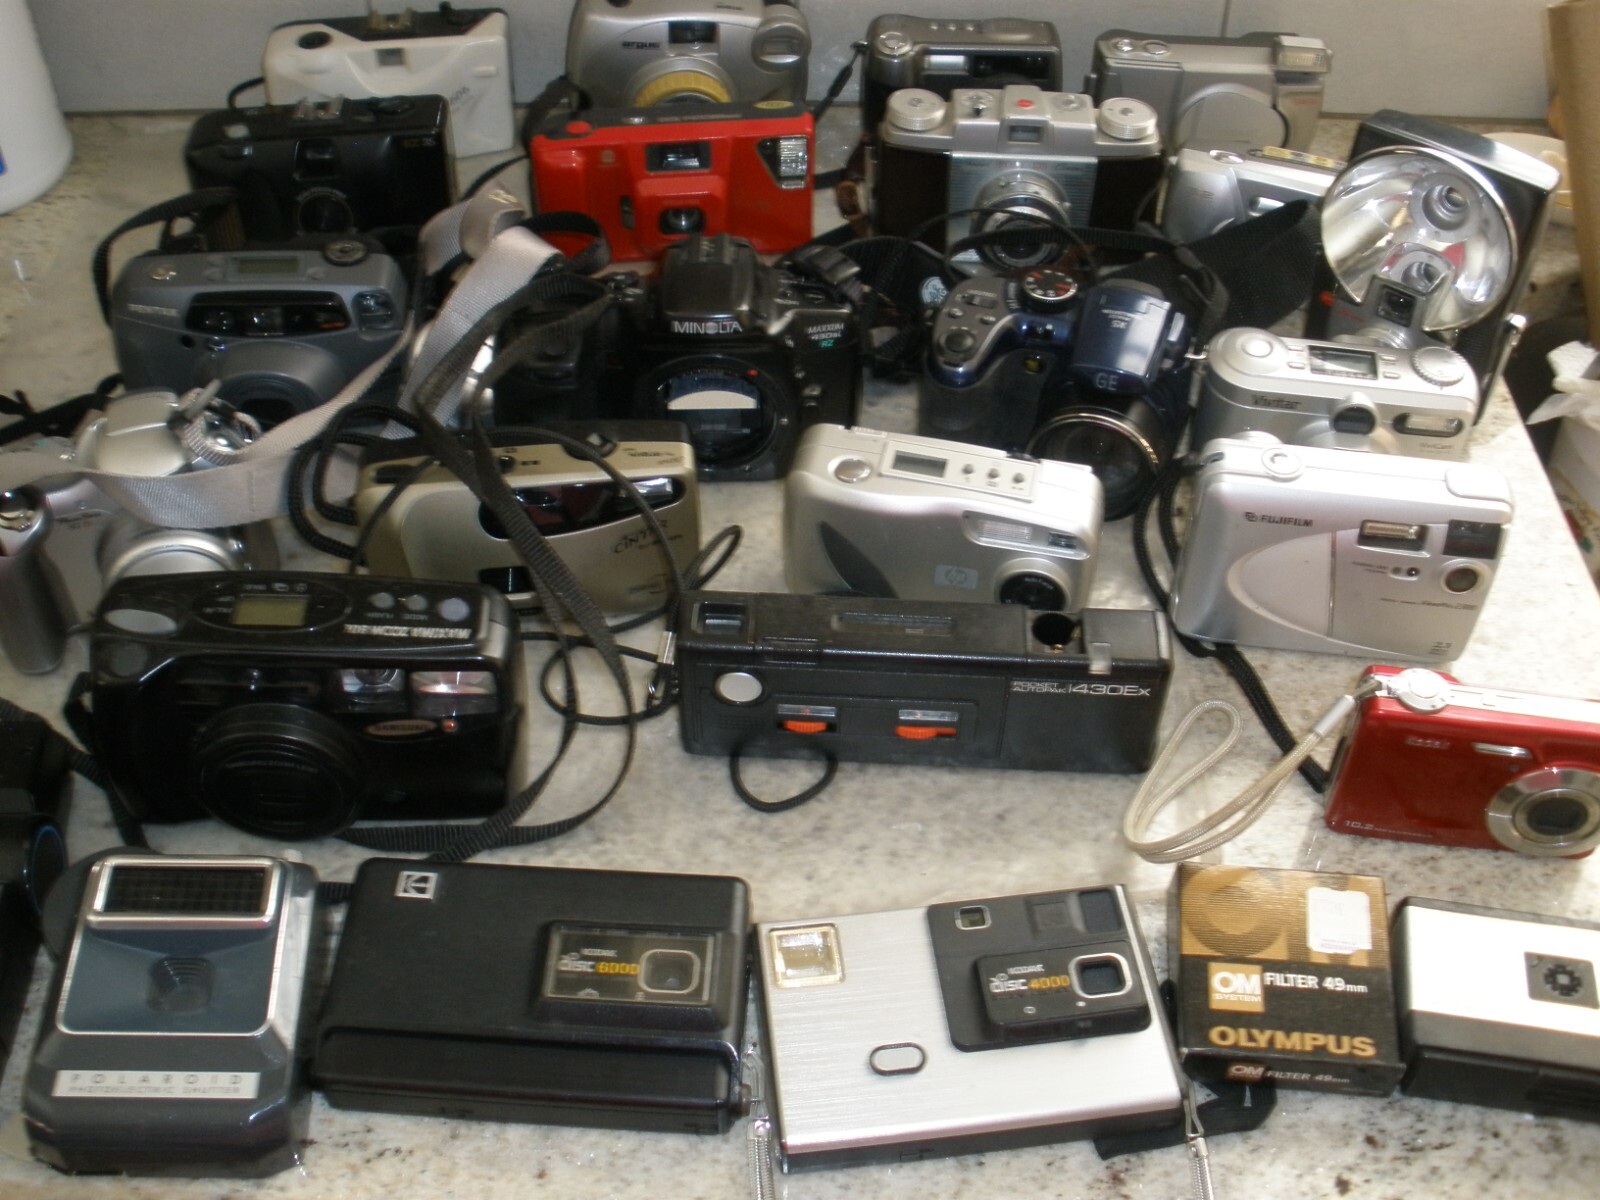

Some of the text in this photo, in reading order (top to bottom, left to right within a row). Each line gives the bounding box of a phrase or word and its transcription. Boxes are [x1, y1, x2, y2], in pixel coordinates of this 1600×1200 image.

[622, 41, 660, 50] argus
[672, 320, 743, 335] MINOLTA
[807, 323, 844, 335] MAXXUM
[1096, 372, 1119, 391] GE
[1251, 394, 1302, 410] Vivitar
[1261, 514, 1314, 528] FUJIFILM
[1011, 680, 1060, 688] POCKET
[596, 962, 640, 975] 6000
[1029, 975, 1071, 990] 4000
[1211, 971, 1368, 995] OM FILTER 49mm
[1213, 993, 1262, 1003] SYSTEM
[1208, 1025, 1378, 1058] OLYMPUS
[70, 1073, 243, 1085] POLAROID
[1230, 1064, 1265, 1077] OM
[1267, 1070, 1312, 1081] FILTER
